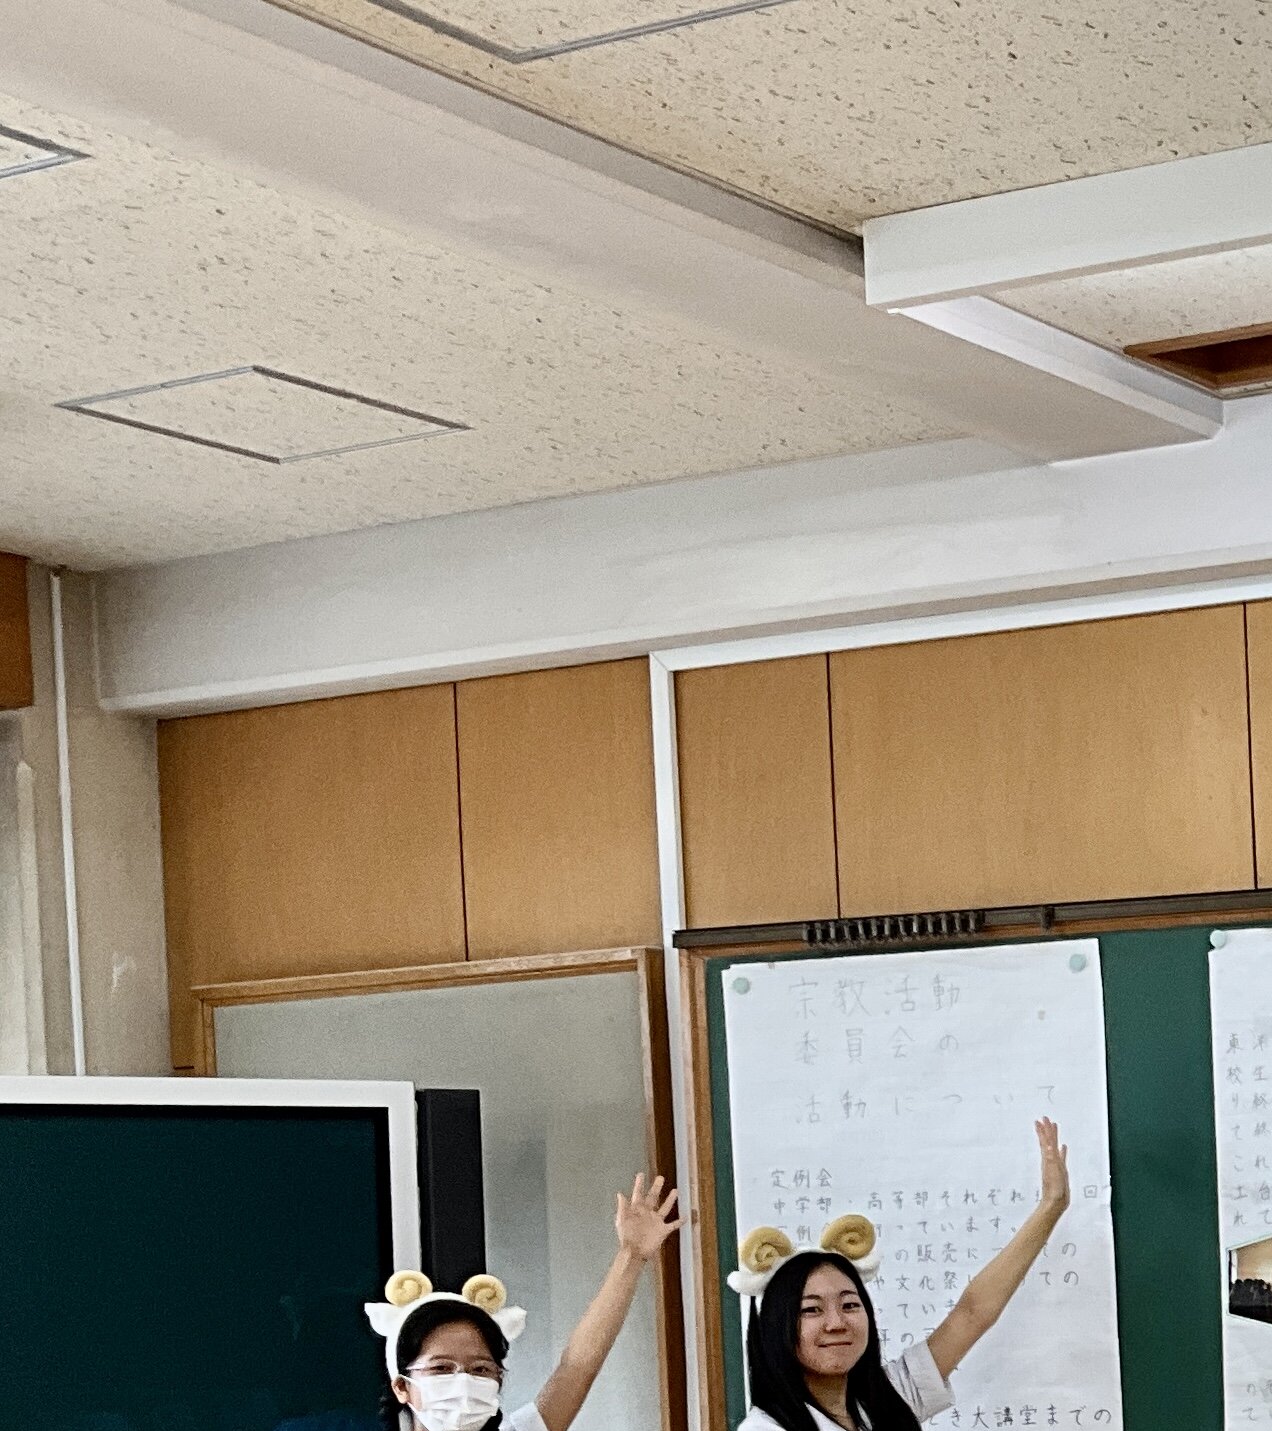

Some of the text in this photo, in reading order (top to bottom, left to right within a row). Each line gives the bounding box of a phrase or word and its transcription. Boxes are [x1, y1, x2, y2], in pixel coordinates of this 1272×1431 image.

[789, 973, 961, 1020] 宗教活動
[795, 1026, 959, 1066] 委員会の
[796, 1085, 1056, 1125] 活動について
[771, 1168, 832, 1190] 定例会
